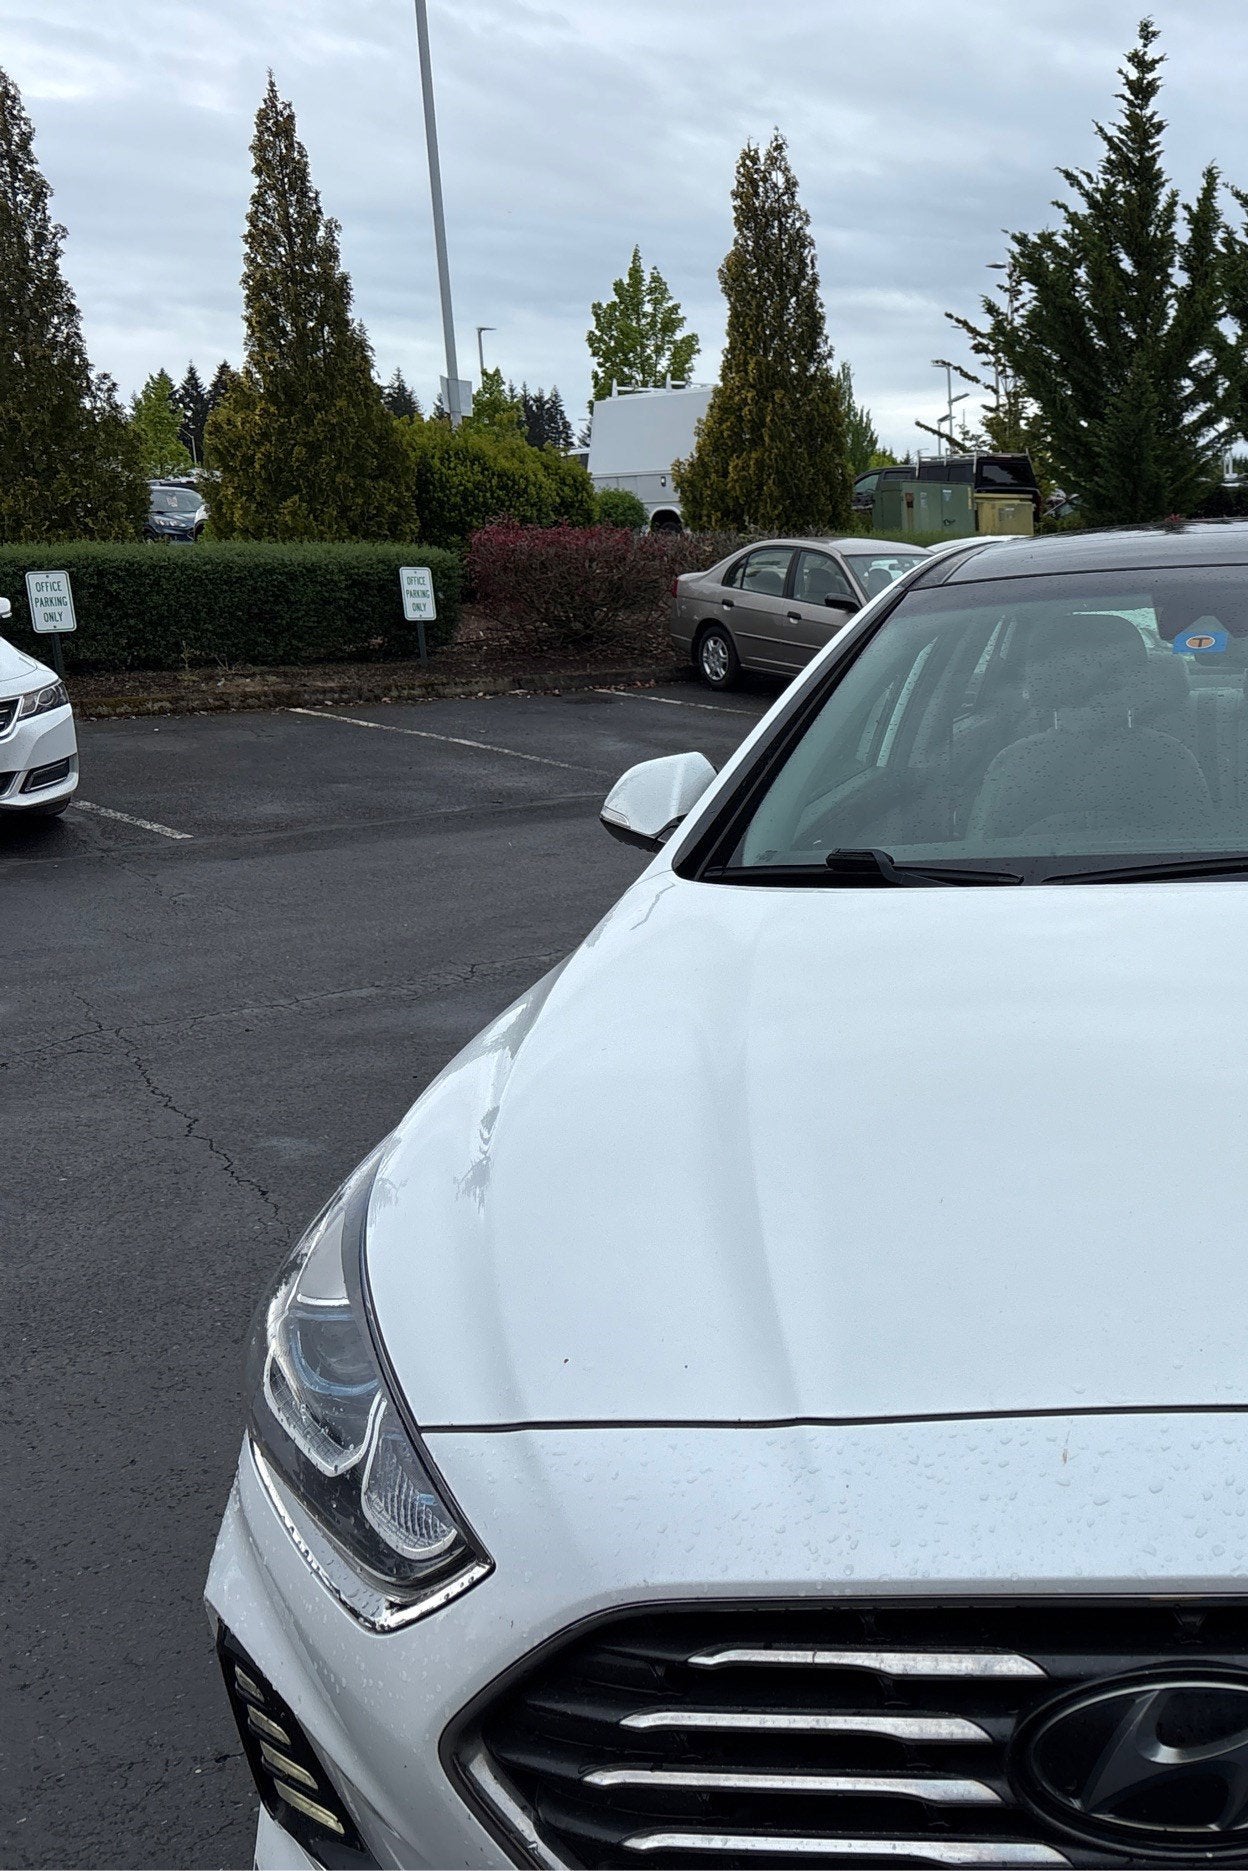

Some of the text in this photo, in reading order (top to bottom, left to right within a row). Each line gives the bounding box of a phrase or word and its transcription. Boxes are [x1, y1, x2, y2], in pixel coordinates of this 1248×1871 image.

[35, 580, 63, 593] OFFICE
[406, 576, 427, 586] OFFICE
[405, 589, 430, 599] PARKING
[34, 596, 68, 608] PARKING
[411, 602, 427, 612] ONLY
[43, 611, 63, 623] ONLY
